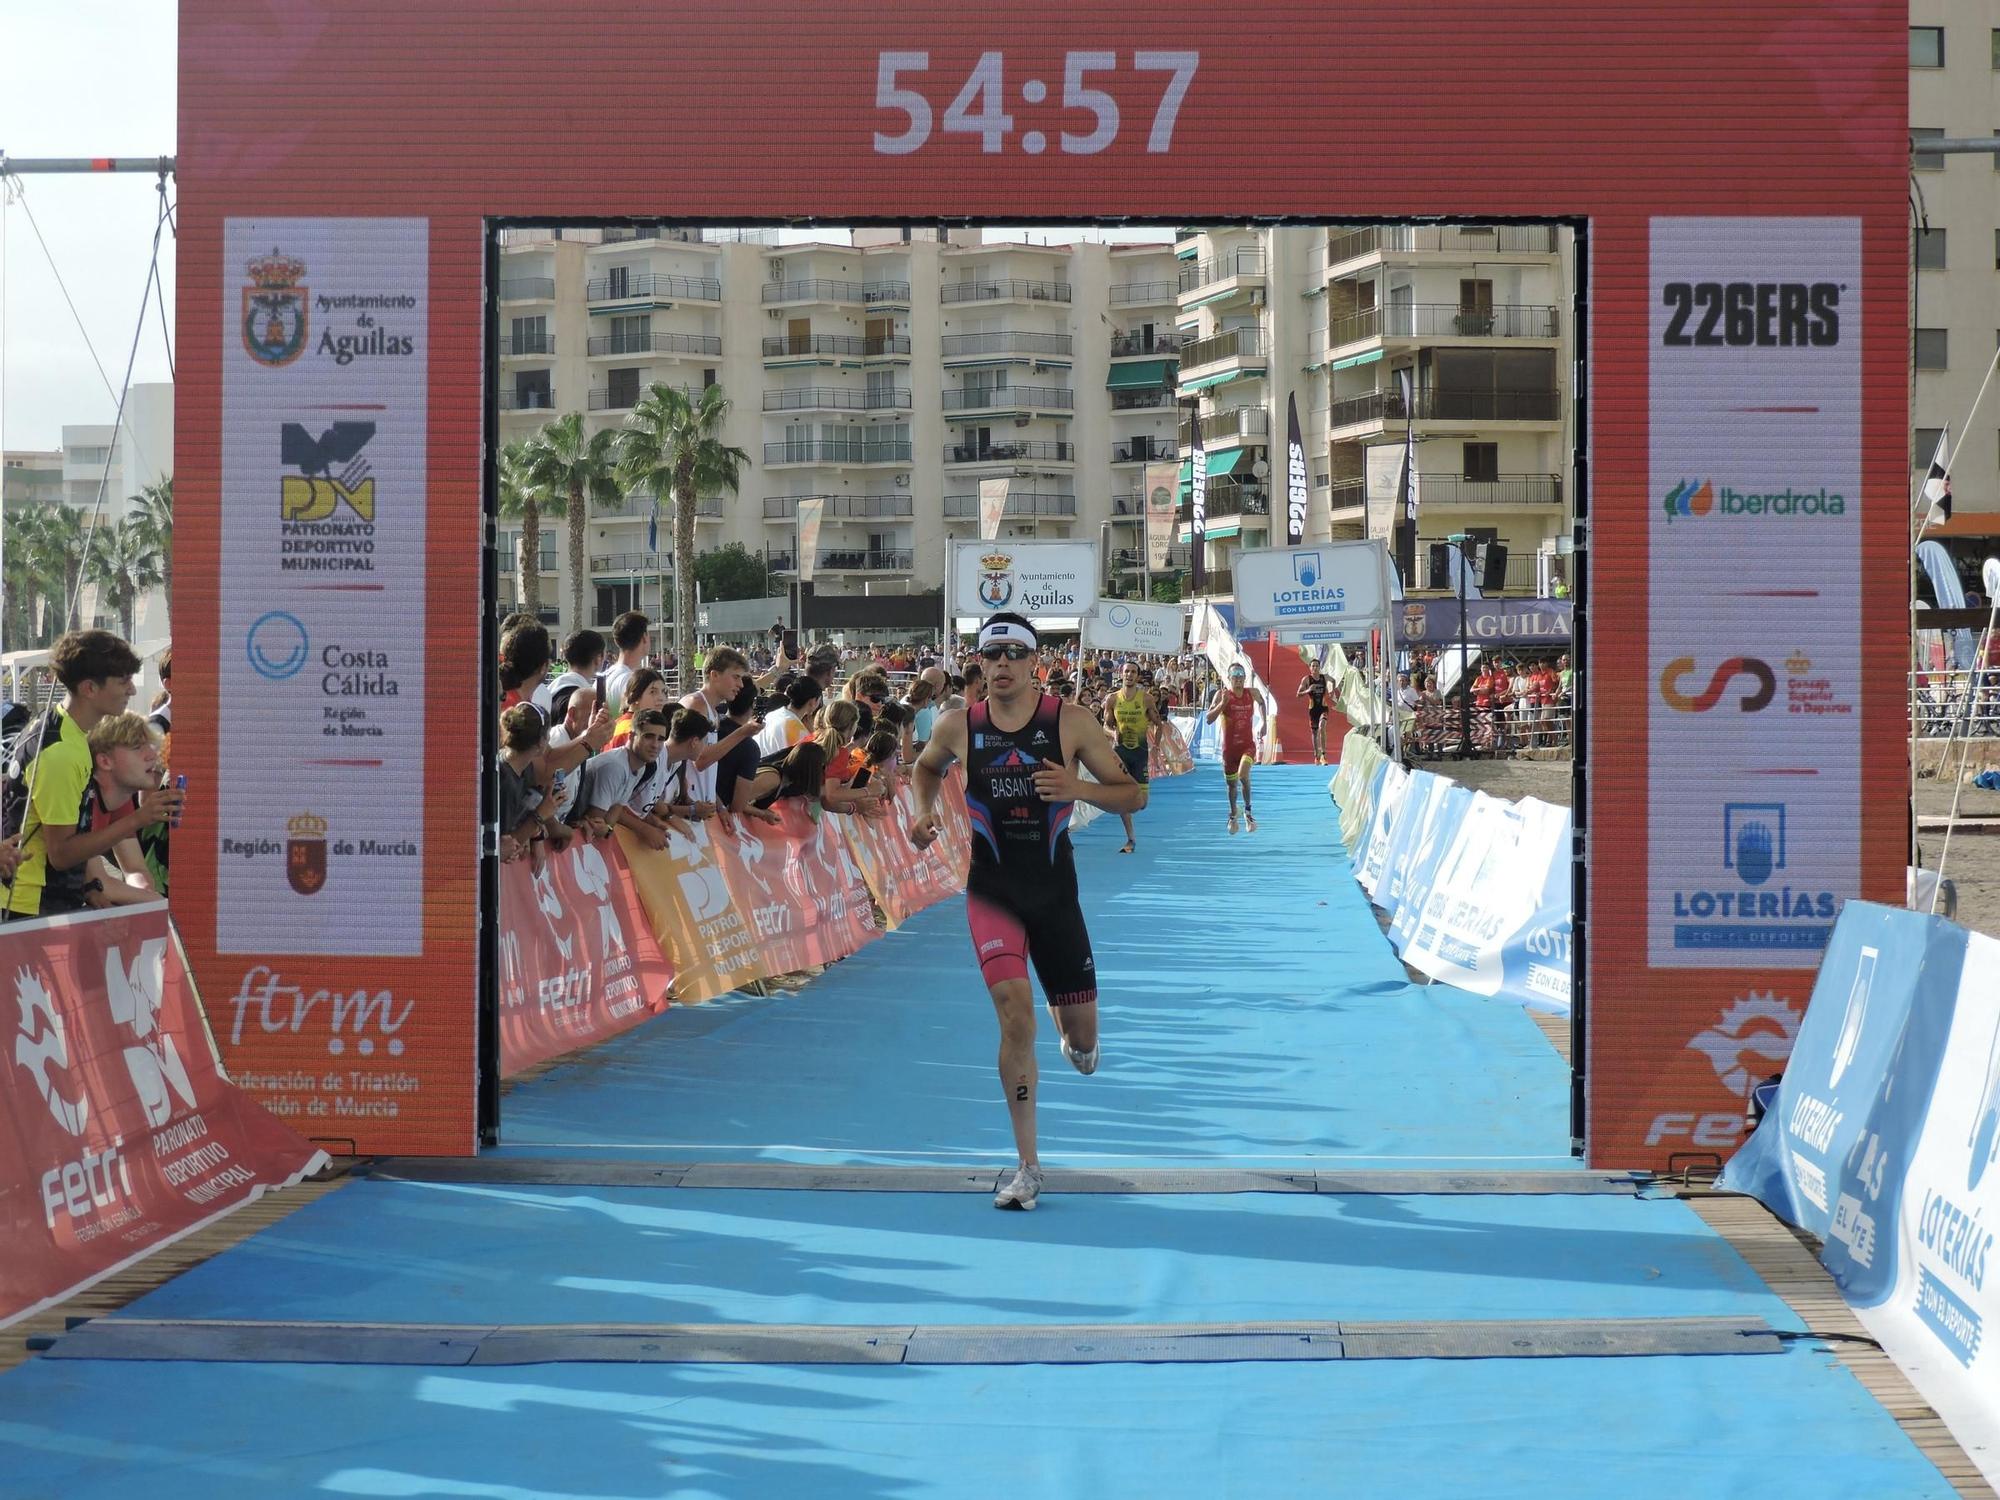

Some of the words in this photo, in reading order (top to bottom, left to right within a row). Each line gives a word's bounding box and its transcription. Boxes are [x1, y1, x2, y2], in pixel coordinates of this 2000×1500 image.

[873, 51, 1199, 154] 54:57
[315, 295, 416, 313] Ayuntamiento
[357, 313, 373, 328] de
[1663, 282, 1840, 346] 226ERS
[317, 327, 413, 365] Águilas
[1289, 442, 1307, 536] 226ERS
[1720, 488, 1844, 515] Iberdrola
[281, 523, 374, 536] PATRONATO
[281, 541, 374, 553] DEPORTIVO
[281, 558, 374, 570] MUNICIPAL
[1018, 572, 1076, 583] Ayuntamiento
[1043, 583, 1052, 591] de
[1020, 592, 1074, 610] Águilas
[1273, 587, 1345, 602] LOTERÍAS
[1308, 604, 1338, 612] DEPORTE
[1135, 617, 1159, 627] Costa
[322, 645, 388, 668] Costa
[322, 672, 399, 696] Cálida
[324, 707, 365, 722] Región
[324, 725, 337, 736] de
[342, 725, 383, 736] Murcia
[223, 839, 281, 858] Región
[333, 840, 353, 855] de
[359, 840, 417, 855] Murcia
[1674, 886, 1834, 918] LOTERÍAS
[1535, 972, 1550, 988] CON
[1551, 978, 1561, 990] EL
[230, 965, 414, 1045] ftrm
[322, 1073, 343, 1090] de
[350, 1072, 419, 1091] Triatlón
[1017, 1085, 1028, 1101] 2
[307, 1097, 328, 1115] de
[335, 1096, 399, 1116] Murcia
[1789, 1092, 1844, 1154] LOTERÍAS
[163, 1142, 229, 1187] DEPORTIVO
[183, 1164, 256, 1205] MUNICIPAL
[1918, 1188, 1993, 1292] LOTERÍAS
[1924, 1283, 1938, 1313] CON
[1937, 1293, 1947, 1323] EL
[1945, 1303, 1975, 1349] DEPORTE
